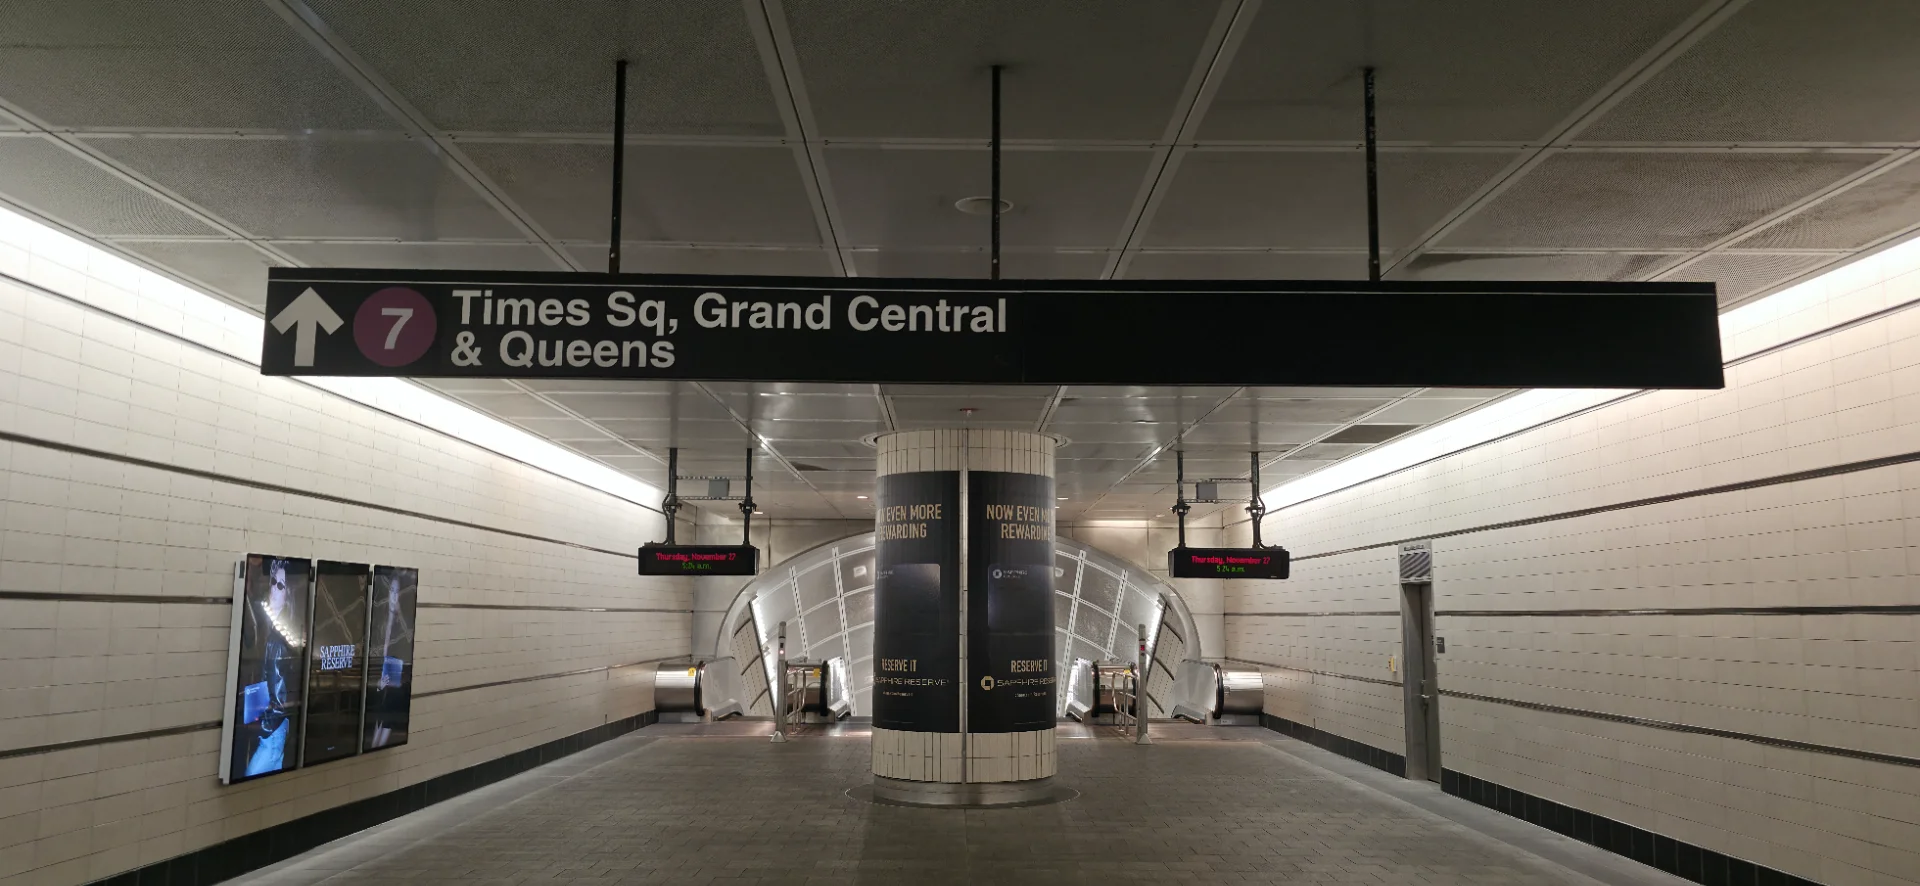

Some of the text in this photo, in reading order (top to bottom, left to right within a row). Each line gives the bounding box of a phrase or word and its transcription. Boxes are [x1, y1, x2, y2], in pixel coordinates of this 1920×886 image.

[452, 289, 1006, 337] Times Sq, Grand Central
[381, 307, 413, 350] 7
[450, 330, 676, 368] & Queens
[886, 505, 907, 522] EVEN
[910, 503, 942, 520] MORE
[986, 504, 1014, 520] NOW
[1016, 505, 1040, 522] EVEN
[655, 552, 691, 562] Thursday,
[692, 552, 727, 561] November
[1191, 555, 1225, 565] Thursday,
[1226, 556, 1261, 565] November
[320, 644, 355, 658] SAPPHIRE
[321, 656, 353, 670] RESERVE
[1010, 659, 1042, 673] RESERVE
